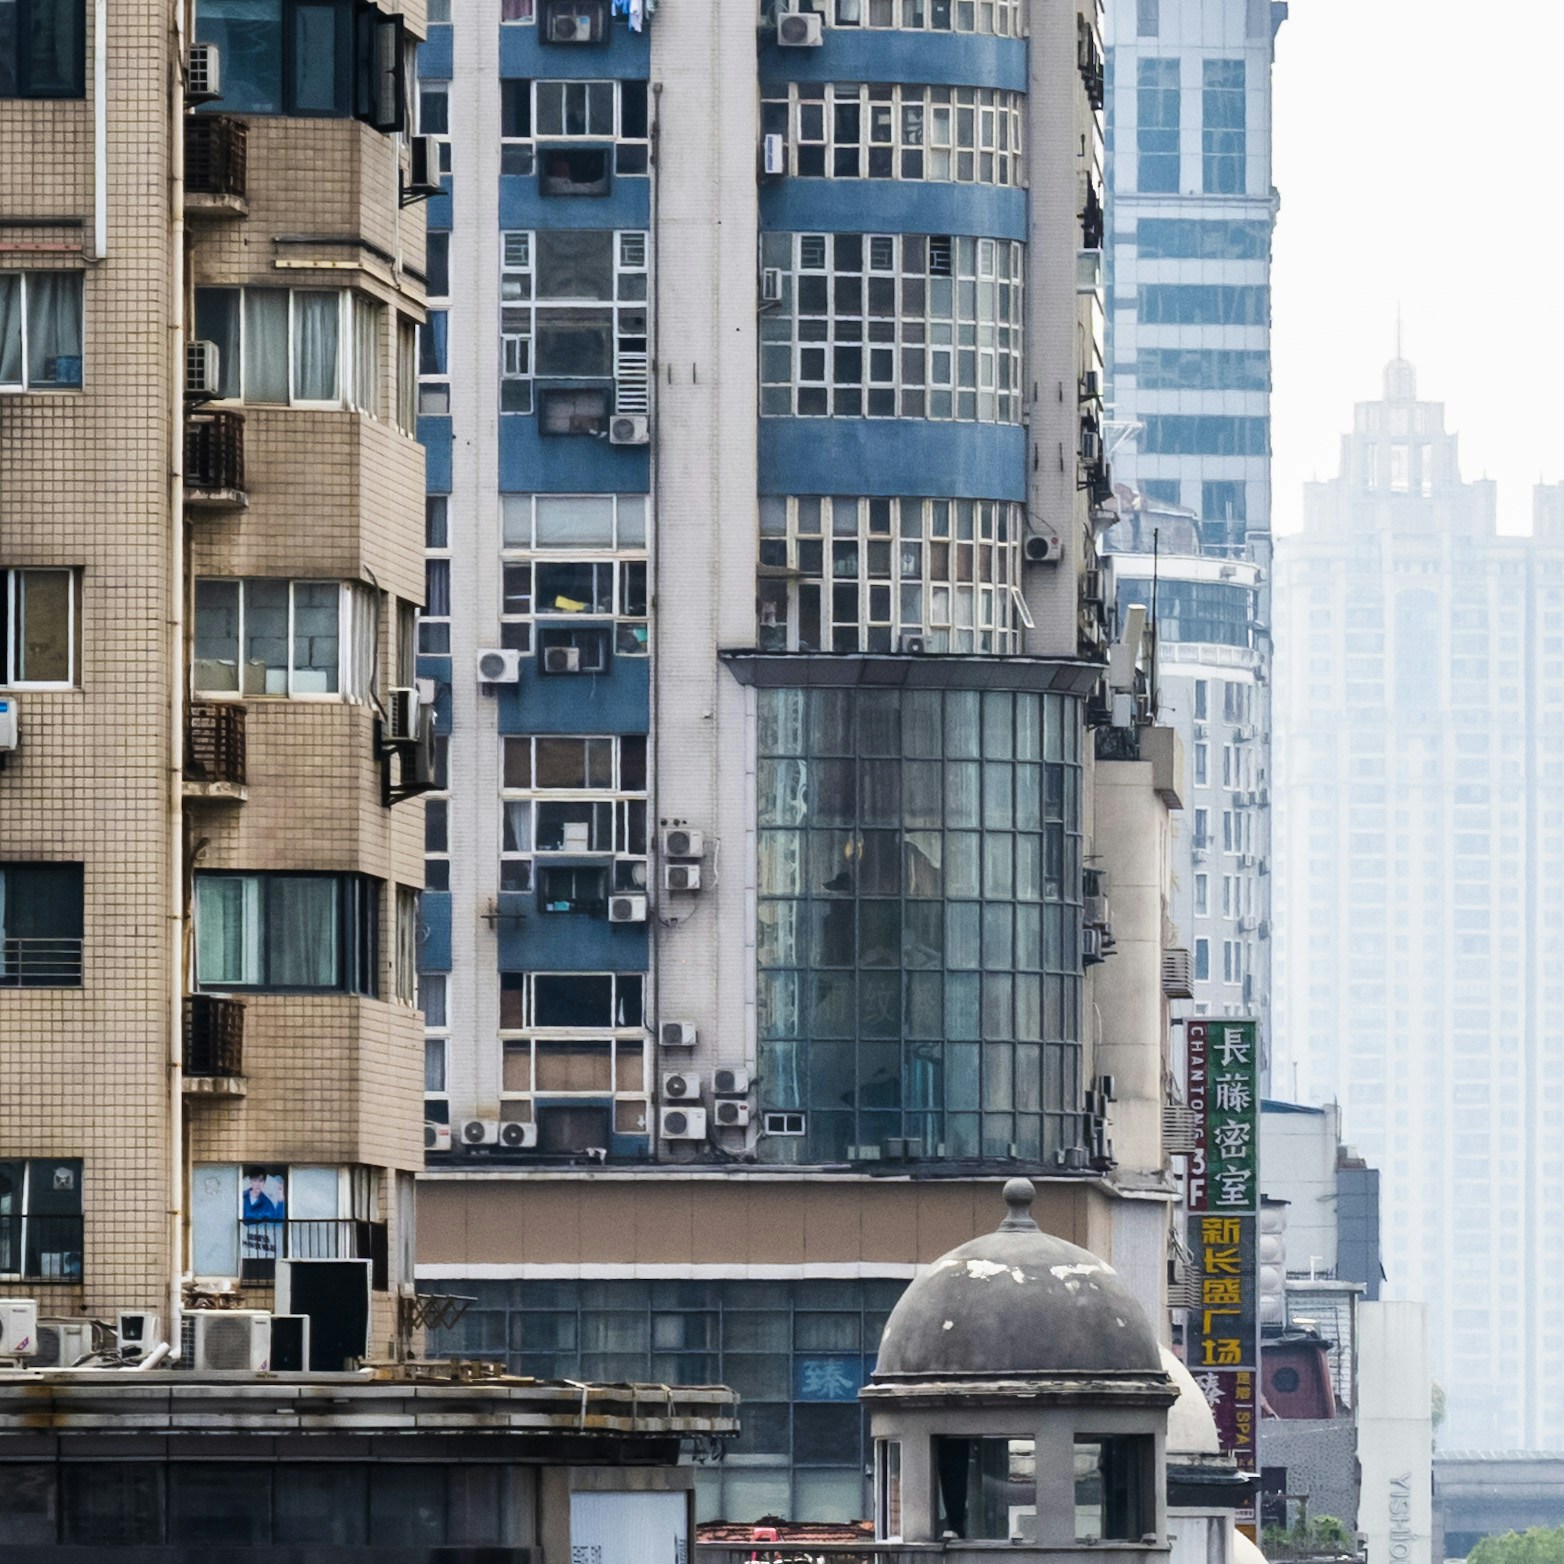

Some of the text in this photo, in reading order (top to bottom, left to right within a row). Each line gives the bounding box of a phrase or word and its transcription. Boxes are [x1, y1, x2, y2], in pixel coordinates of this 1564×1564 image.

[1214, 1026, 1252, 1206] 長藤密室
[1189, 1148, 1205, 1207] 3F
[1202, 1217, 1242, 1367] 新长盛广场
[1236, 1411, 1250, 1445] SPA
